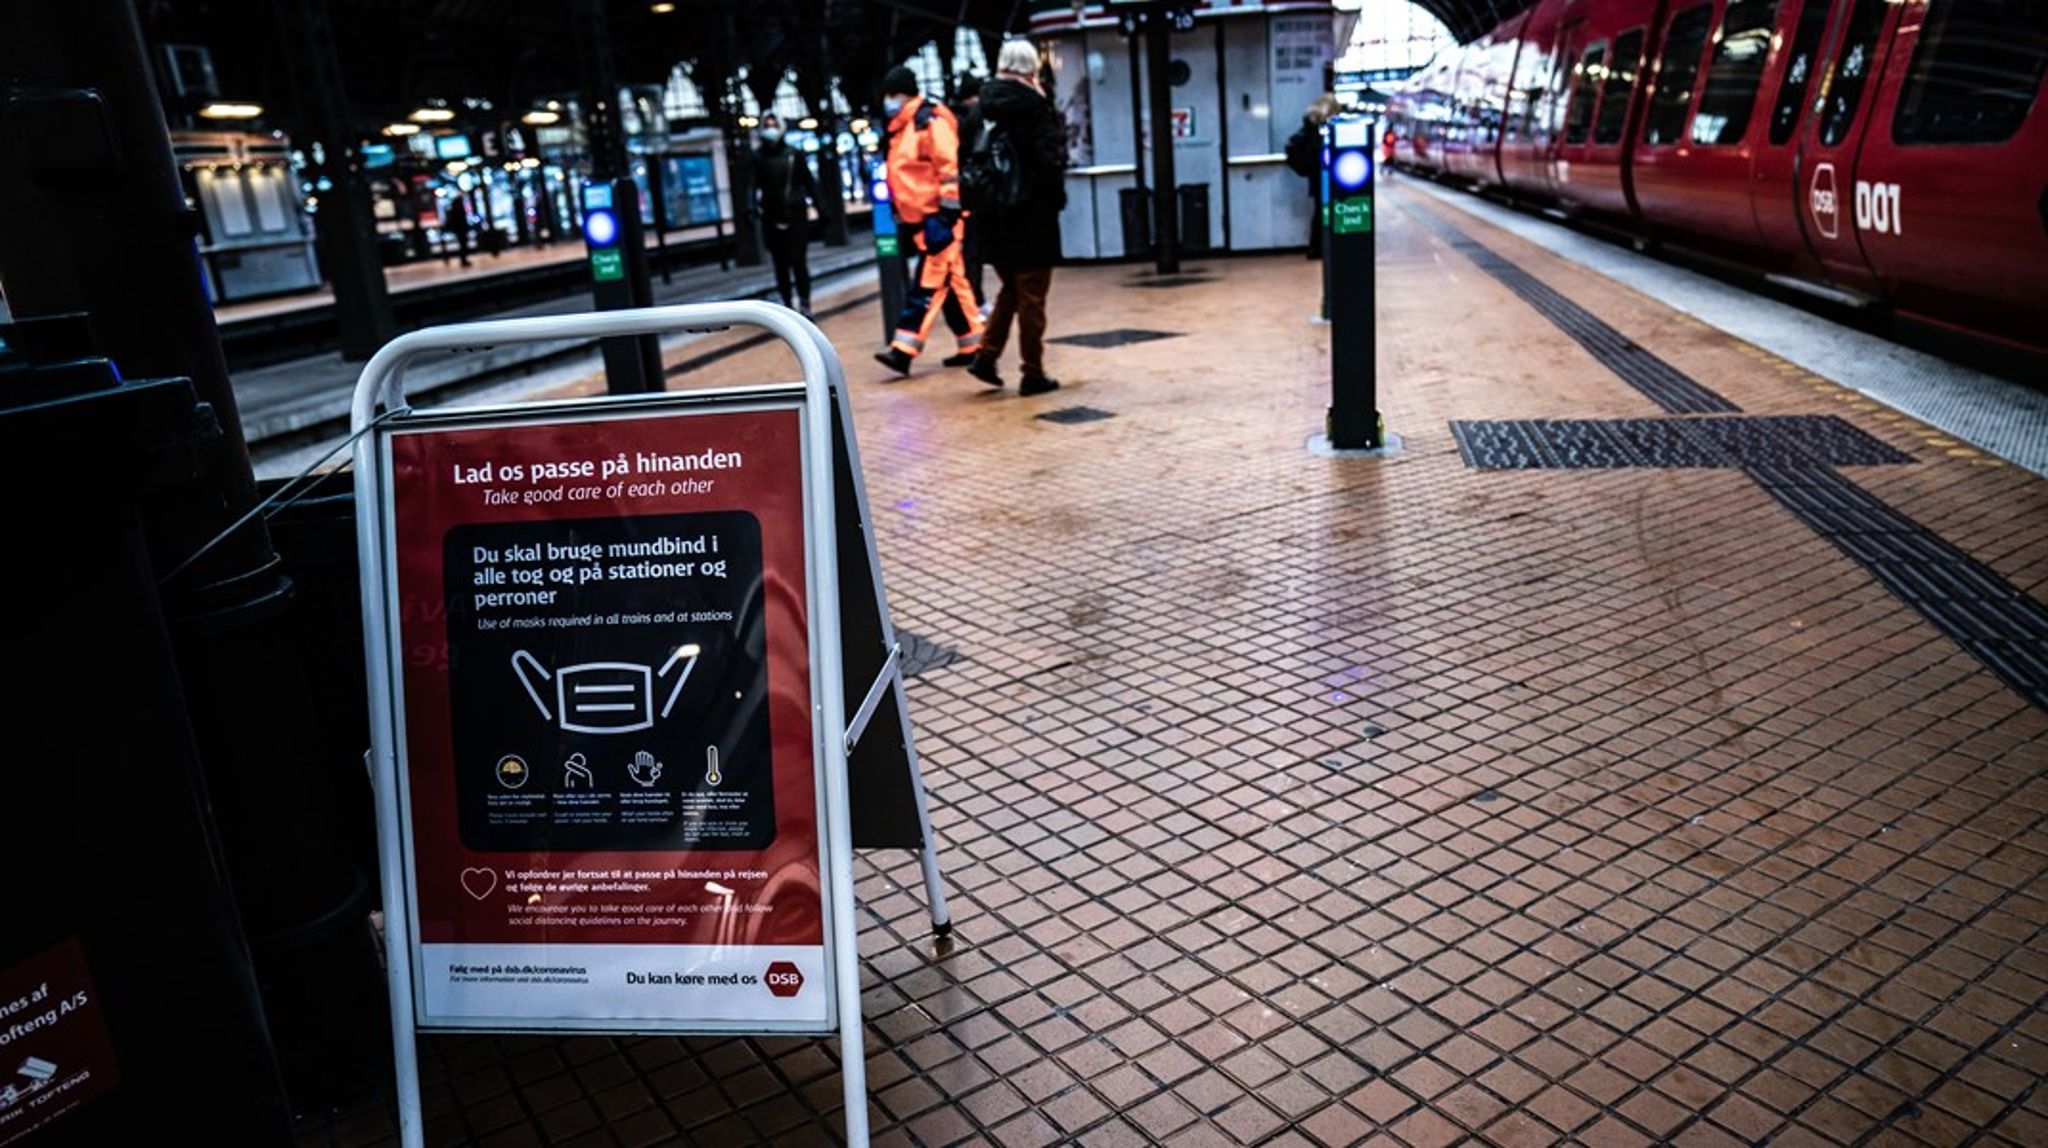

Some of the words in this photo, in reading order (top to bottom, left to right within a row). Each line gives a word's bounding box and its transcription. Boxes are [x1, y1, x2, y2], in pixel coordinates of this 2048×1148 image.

[454, 462, 493, 484] Lad
[499, 464, 524, 481] os
[531, 460, 595, 485] passe
[601, 452, 630, 480] på
[636, 447, 742, 473] hinanden
[483, 488, 520, 506] Take
[524, 485, 564, 506] good
[568, 485, 602, 500] care
[606, 480, 625, 499] of
[628, 480, 666, 497] each
[671, 477, 714, 496] other
[474, 546, 499, 563] Du
[505, 543, 541, 563] skal
[547, 542, 603, 562] bruge
[608, 535, 706, 557] mundbind
[712, 535, 719, 553] i
[474, 567, 506, 585] alle
[511, 567, 544, 586] tog
[549, 566, 574, 585] og
[579, 561, 603, 585] på
[608, 560, 695, 580] stationer
[700, 560, 727, 579] og
[474, 590, 558, 611] perroner
[478, 617, 498, 630] Use
[499, 616, 512, 629] of
[513, 616, 546, 629] masks
[548, 613, 592, 629] required
[593, 613, 604, 626] in
[606, 613, 619, 625] all
[621, 612, 651, 625] trains
[653, 611, 675, 623] and
[676, 611, 689, 623] at
[691, 610, 733, 622] stations
[505, 870, 515, 879] Vi
[517, 869, 561, 881] opfordrer
[577, 869, 609, 880] fortsat
[611, 870, 621, 880] til
[623, 870, 633, 879] at
[634, 871, 662, 881] passe
[663, 869, 676, 881] på
[678, 869, 722, 880] hinanden
[723, 868, 736, 881] på
[738, 869, 768, 880] rejsen
[505, 884, 519, 894] og
[545, 883, 557, 892] de
[570, 905, 587, 915] you
[600, 903, 619, 913] take
[621, 904, 644, 914] good
[645, 904, 664, 913] care
[665, 903, 676, 913] of
[677, 903, 698, 913] each
[508, 916, 533, 926] social
[534, 916, 577, 927] distancing
[579, 916, 621, 927] guidelines
[623, 918, 634, 926] on
[636, 916, 651, 926] the
[470, 964, 489, 974] med
[626, 972, 646, 985] Du
[648, 972, 673, 985] kan
[675, 971, 705, 985] køre
[707, 973, 738, 985] med
[741, 976, 758, 985] os
[769, 972, 800, 985] DSB
[31, 982, 49, 1003] af
[0, 1009, 58, 1045] ofteng
[60, 990, 88, 1016] A/S
